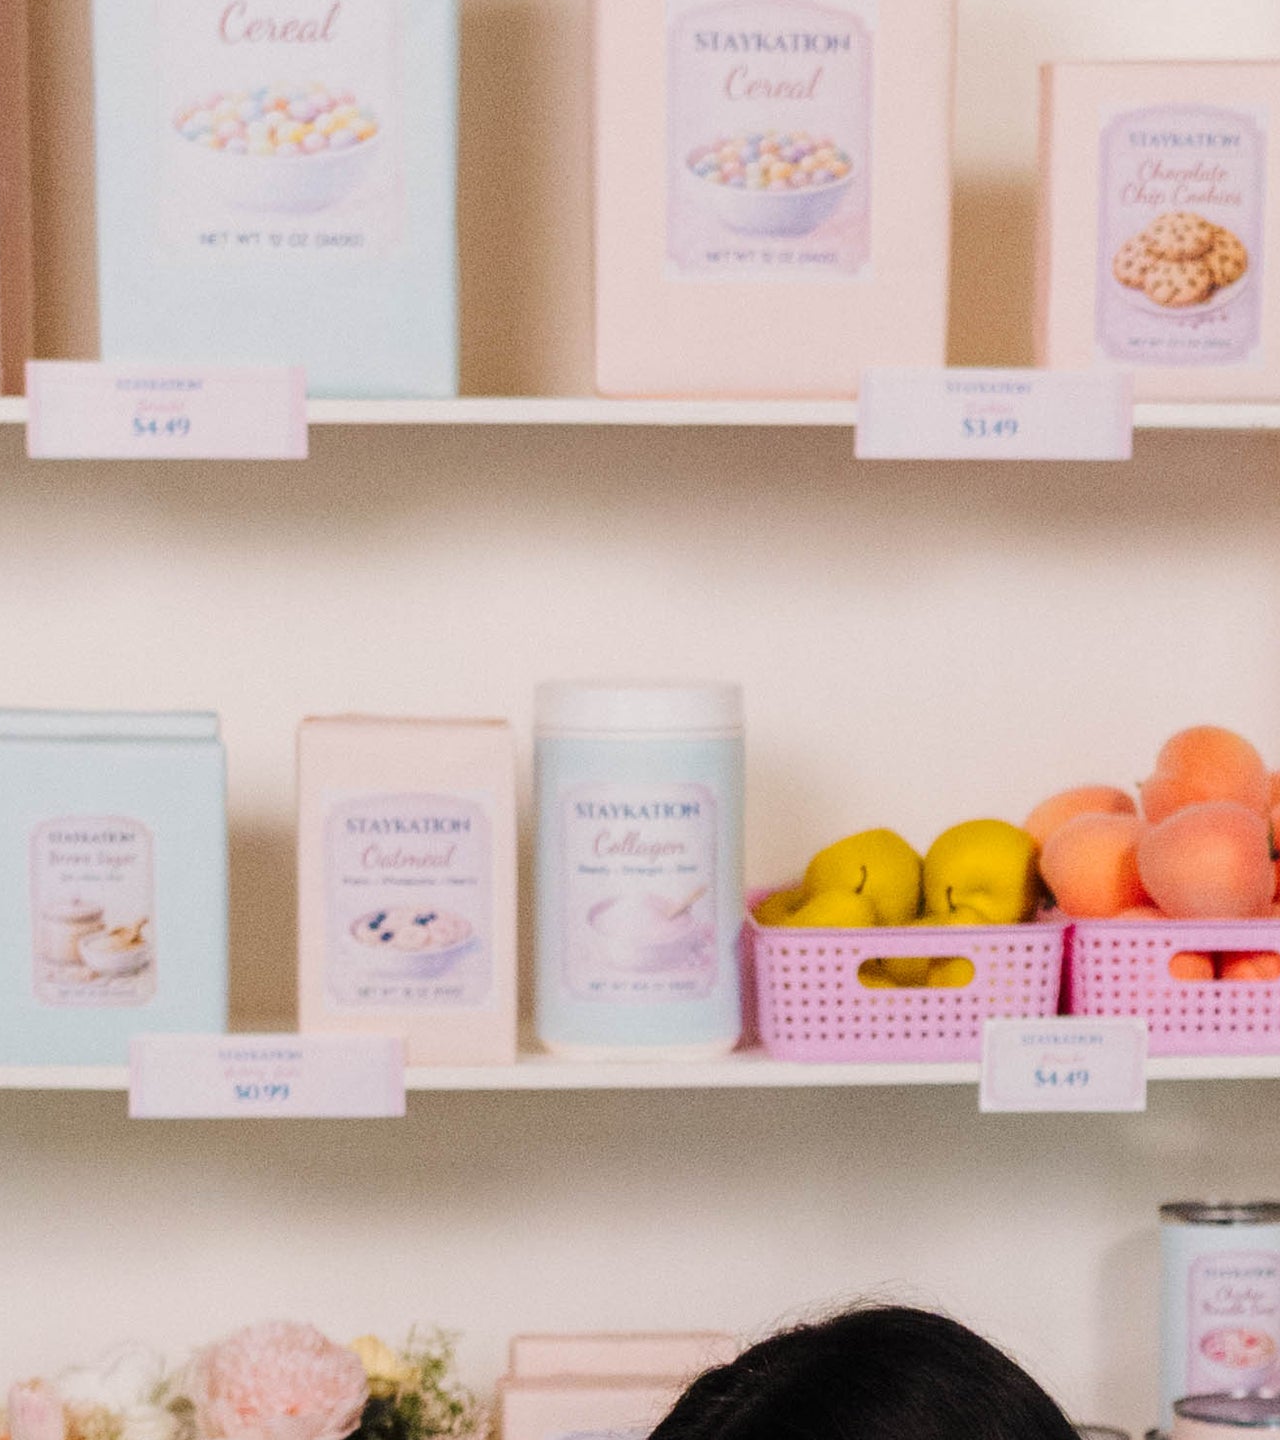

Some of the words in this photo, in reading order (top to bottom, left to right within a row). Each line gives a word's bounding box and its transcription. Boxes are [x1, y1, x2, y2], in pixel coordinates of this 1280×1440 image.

[694, 32, 852, 53] STAYKATION
[724, 64, 823, 101] Cereal
[1128, 132, 1242, 148] STAYKATION
[1136, 159, 1228, 182] Chocolate
[1120, 181, 1166, 210] Chip
[1172, 182, 1242, 206] Cookies
[132, 416, 191, 437] $4.49
[962, 418, 1019, 437] $3.49
[575, 801, 700, 819] STAYKATION
[346, 817, 472, 834] STAYKATION
[48, 832, 136, 844] STAYKATION
[591, 827, 687, 864] Collagen
[359, 842, 457, 872] Oatmeal
[1033, 1067, 1090, 1087] $4.49
